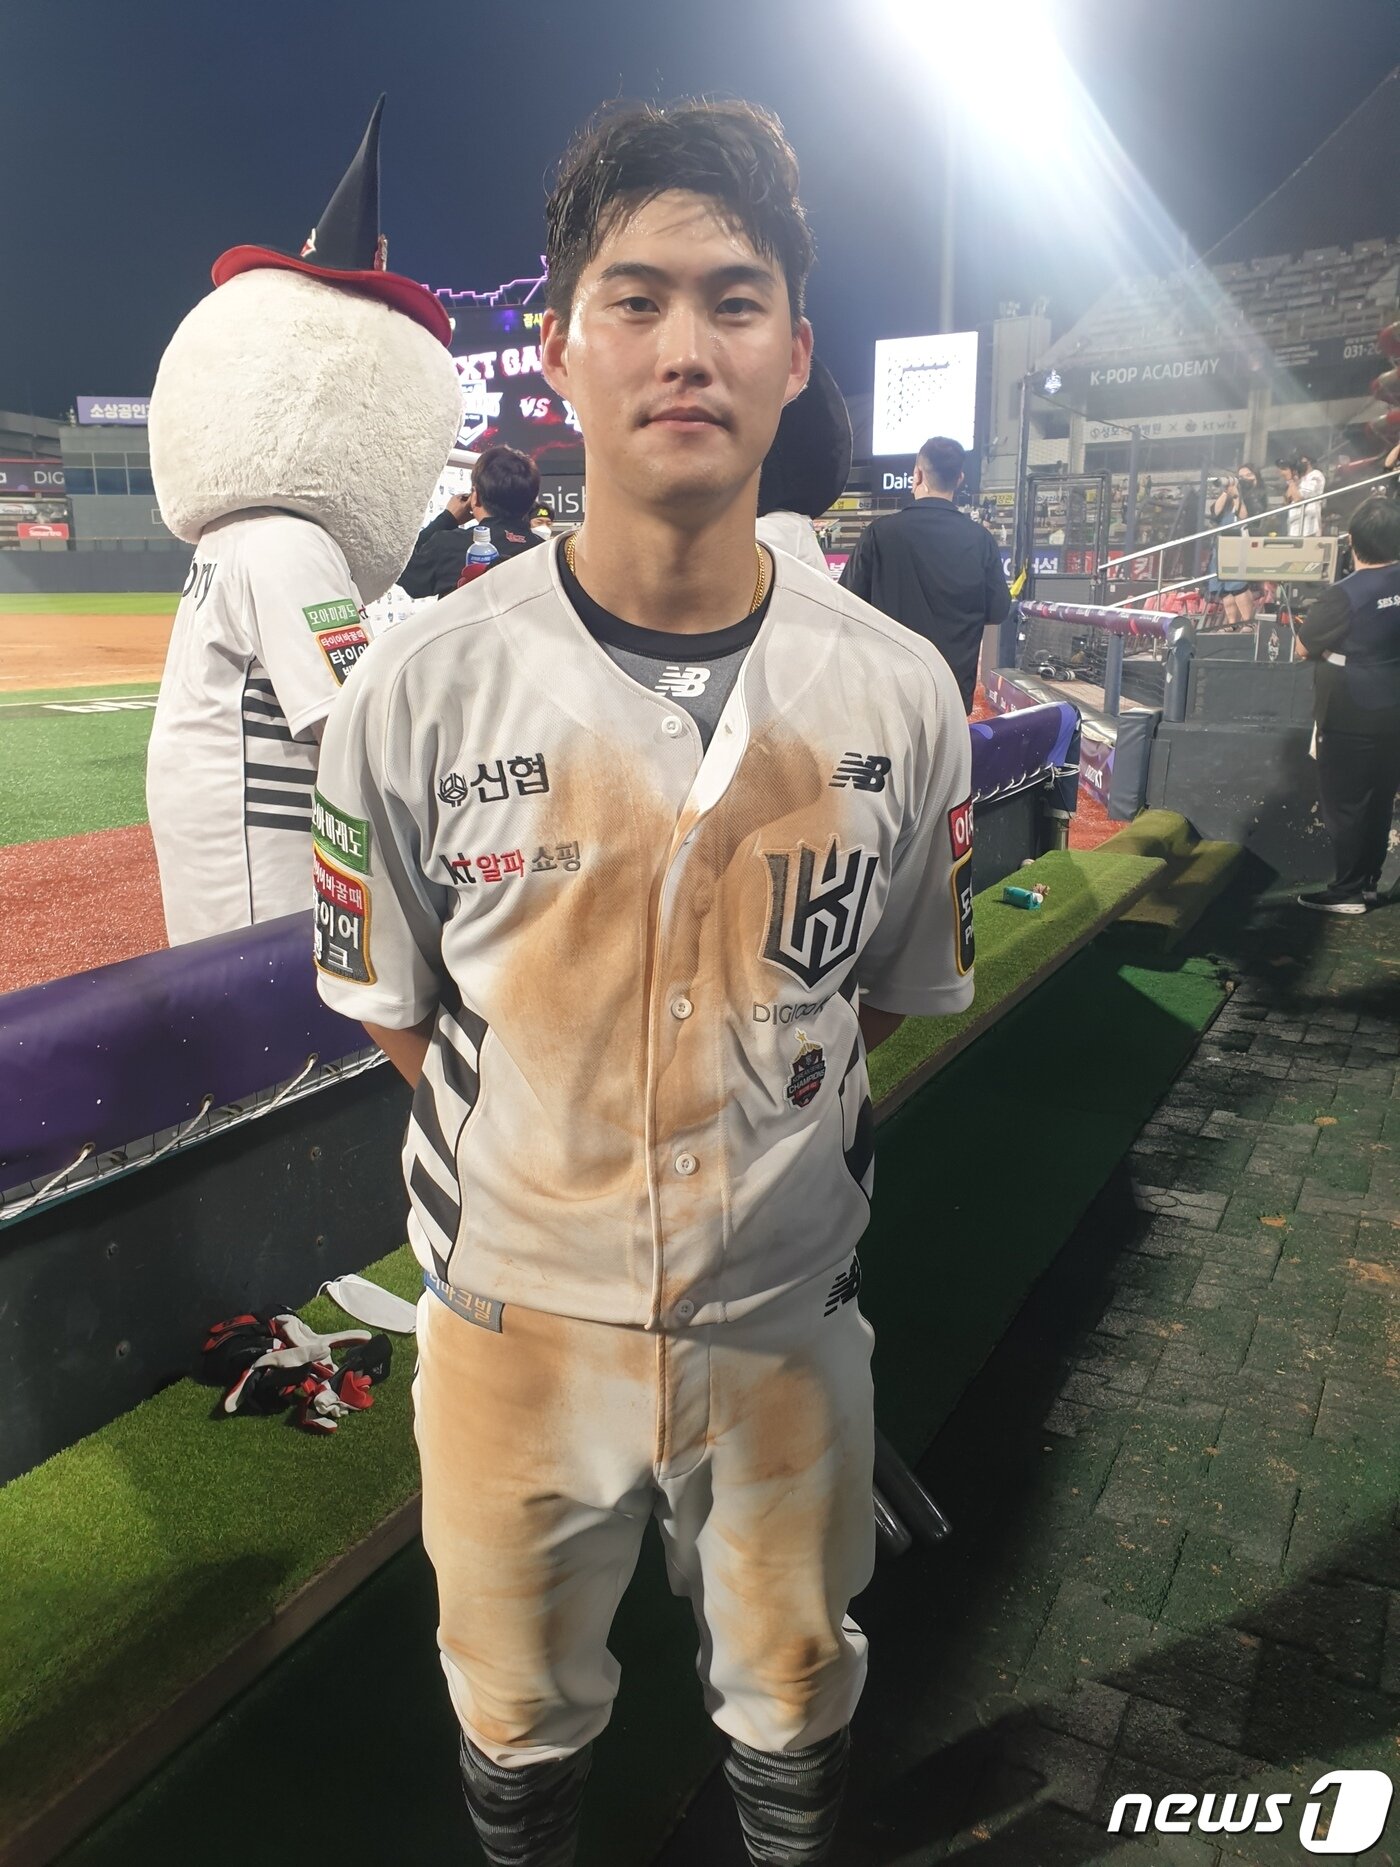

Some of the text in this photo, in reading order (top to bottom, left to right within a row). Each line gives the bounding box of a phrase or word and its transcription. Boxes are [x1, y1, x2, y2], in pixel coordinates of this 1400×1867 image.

[501, 345, 542, 376] GA
[1090, 358, 1220, 386] K-POP ACADEMY
[90, 403, 151, 419] 소상공인
[520, 396, 551, 418] VS
[307, 604, 357, 625] 모아미래도
[470, 753, 549, 802] 신협
[532, 841, 581, 872] 쇼핑
